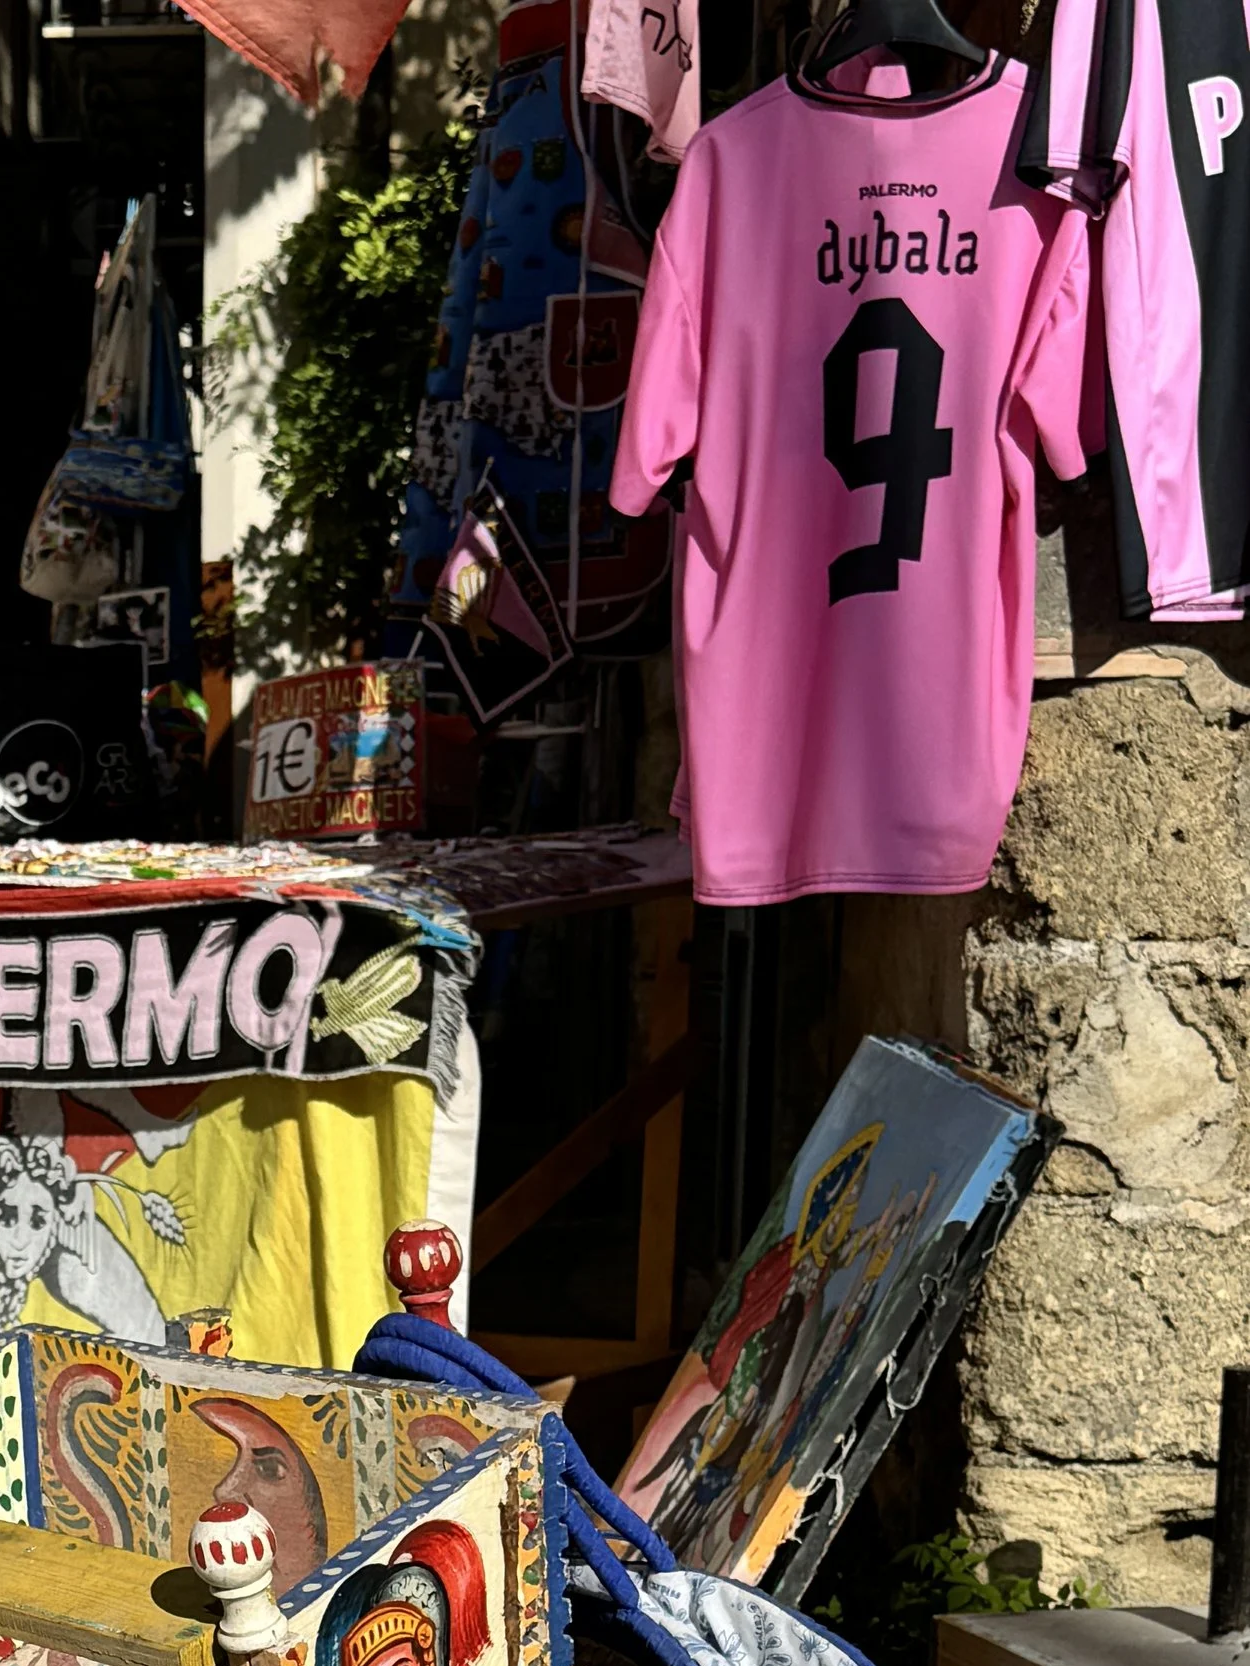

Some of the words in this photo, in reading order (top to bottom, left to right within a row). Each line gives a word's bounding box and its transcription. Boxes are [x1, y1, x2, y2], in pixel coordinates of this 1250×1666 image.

[859, 183, 938, 200] PALERMO
[817, 208, 979, 295] dybala
[823, 297, 953, 608] 9
[257, 721, 313, 798] 1€
[325, 789, 417, 826] MAGNETS
